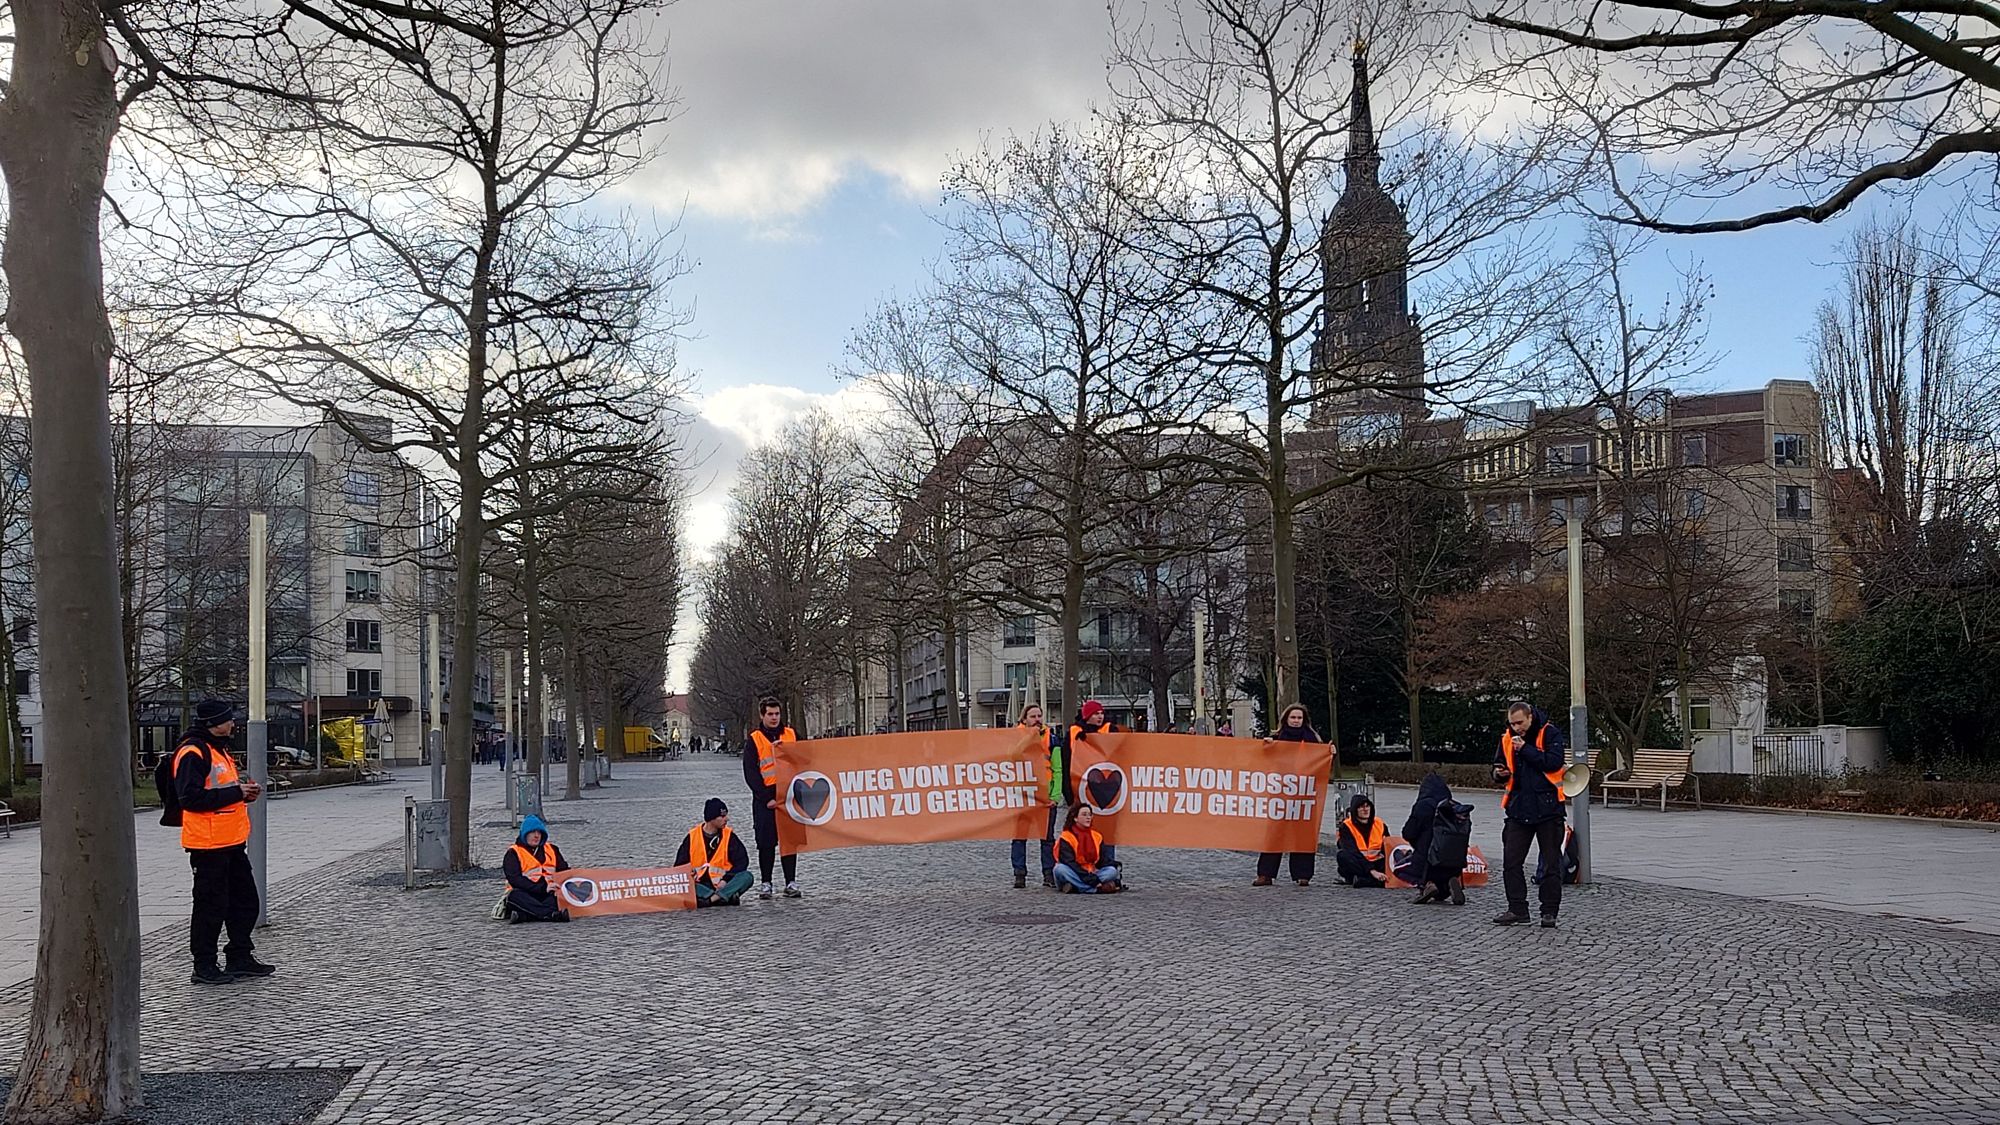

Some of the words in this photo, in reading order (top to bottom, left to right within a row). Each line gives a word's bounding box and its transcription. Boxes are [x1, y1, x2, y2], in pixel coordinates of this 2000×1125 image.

[838, 768, 894, 793] WEG
[898, 764, 949, 789] VON
[953, 761, 1038, 785] FOSSIL
[1130, 765, 1180, 788] WEG
[1184, 767, 1232, 791] VON
[1238, 770, 1317, 796] FOSSIL
[841, 794, 887, 820] HIN
[891, 792, 922, 816] ZU
[926, 786, 1038, 814] GERECHT
[1130, 791, 1169, 814] HIN
[1173, 792, 1202, 815] ZU
[1207, 793, 1316, 821] GERECHT
[600, 880, 625, 889] WEG
[627, 878, 650, 886] VON
[652, 873, 689, 884] FOSSIL
[601, 890, 622, 900] HIN
[623, 888, 638, 898] ZU
[640, 884, 689, 896] GERECHT
